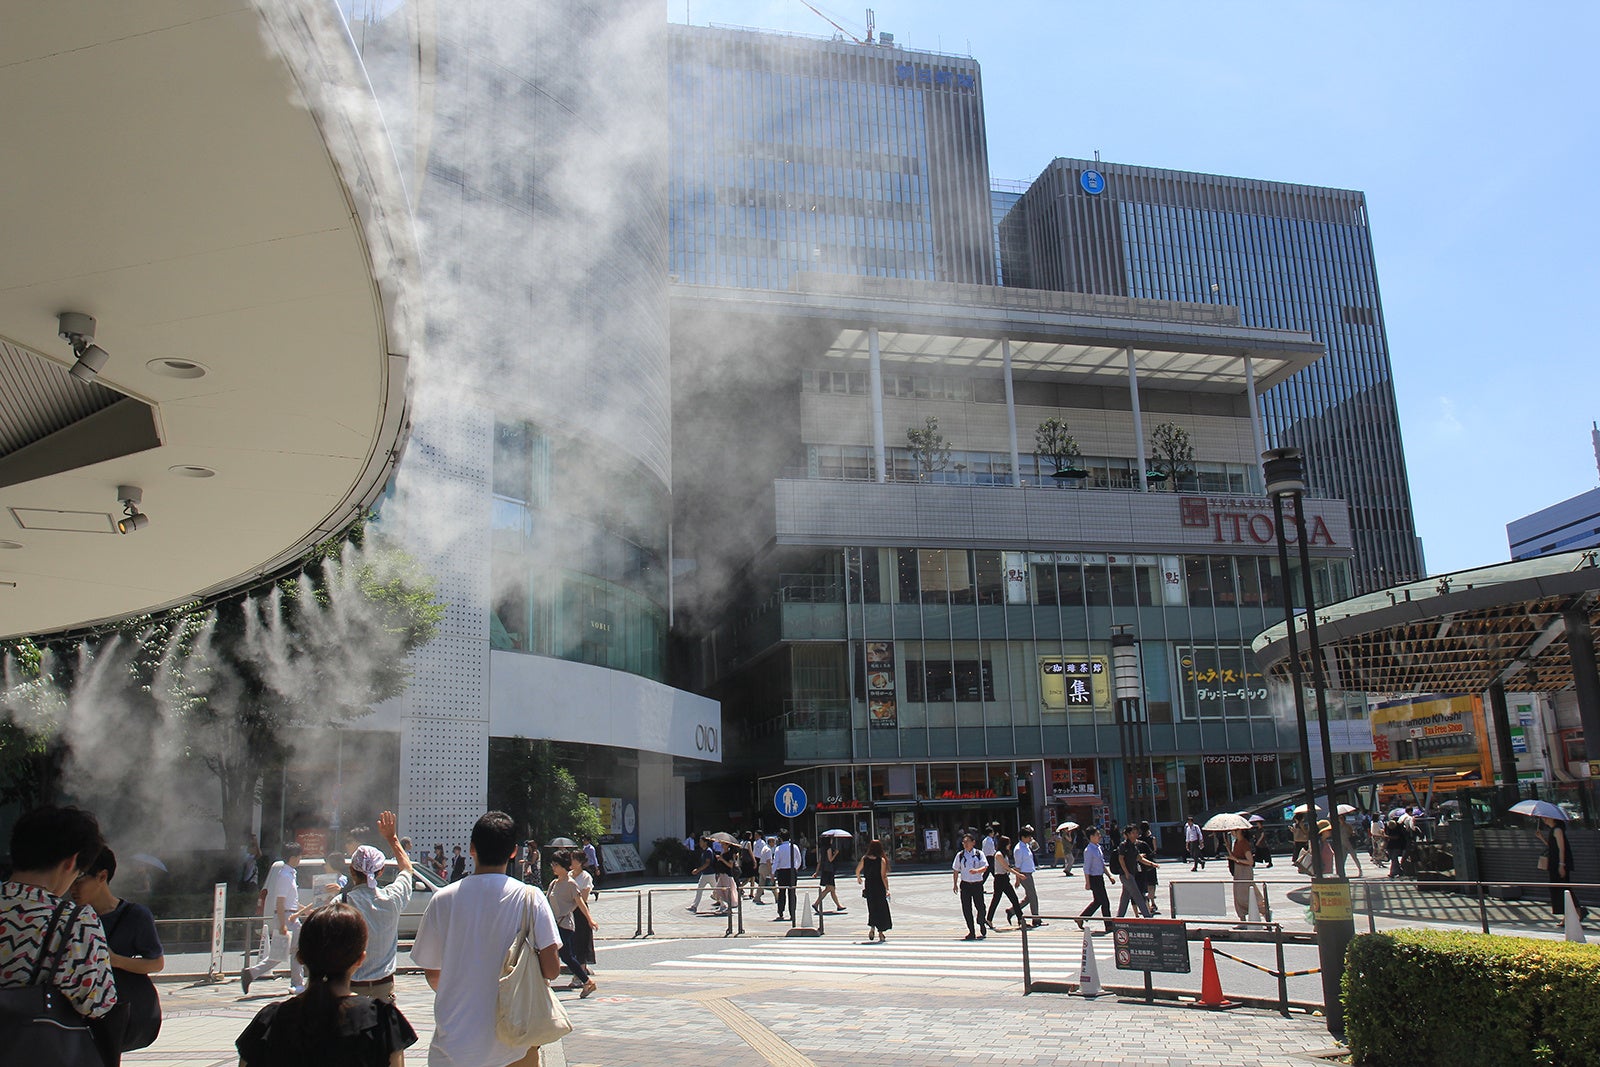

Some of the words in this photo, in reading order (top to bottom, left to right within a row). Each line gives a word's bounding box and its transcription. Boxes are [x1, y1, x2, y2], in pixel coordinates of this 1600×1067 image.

[1069, 679, 1090, 704] 集
[1424, 726, 1436, 735] Tax
[1436, 725, 1448, 734] Free
[1448, 723, 1463, 733] Shop
